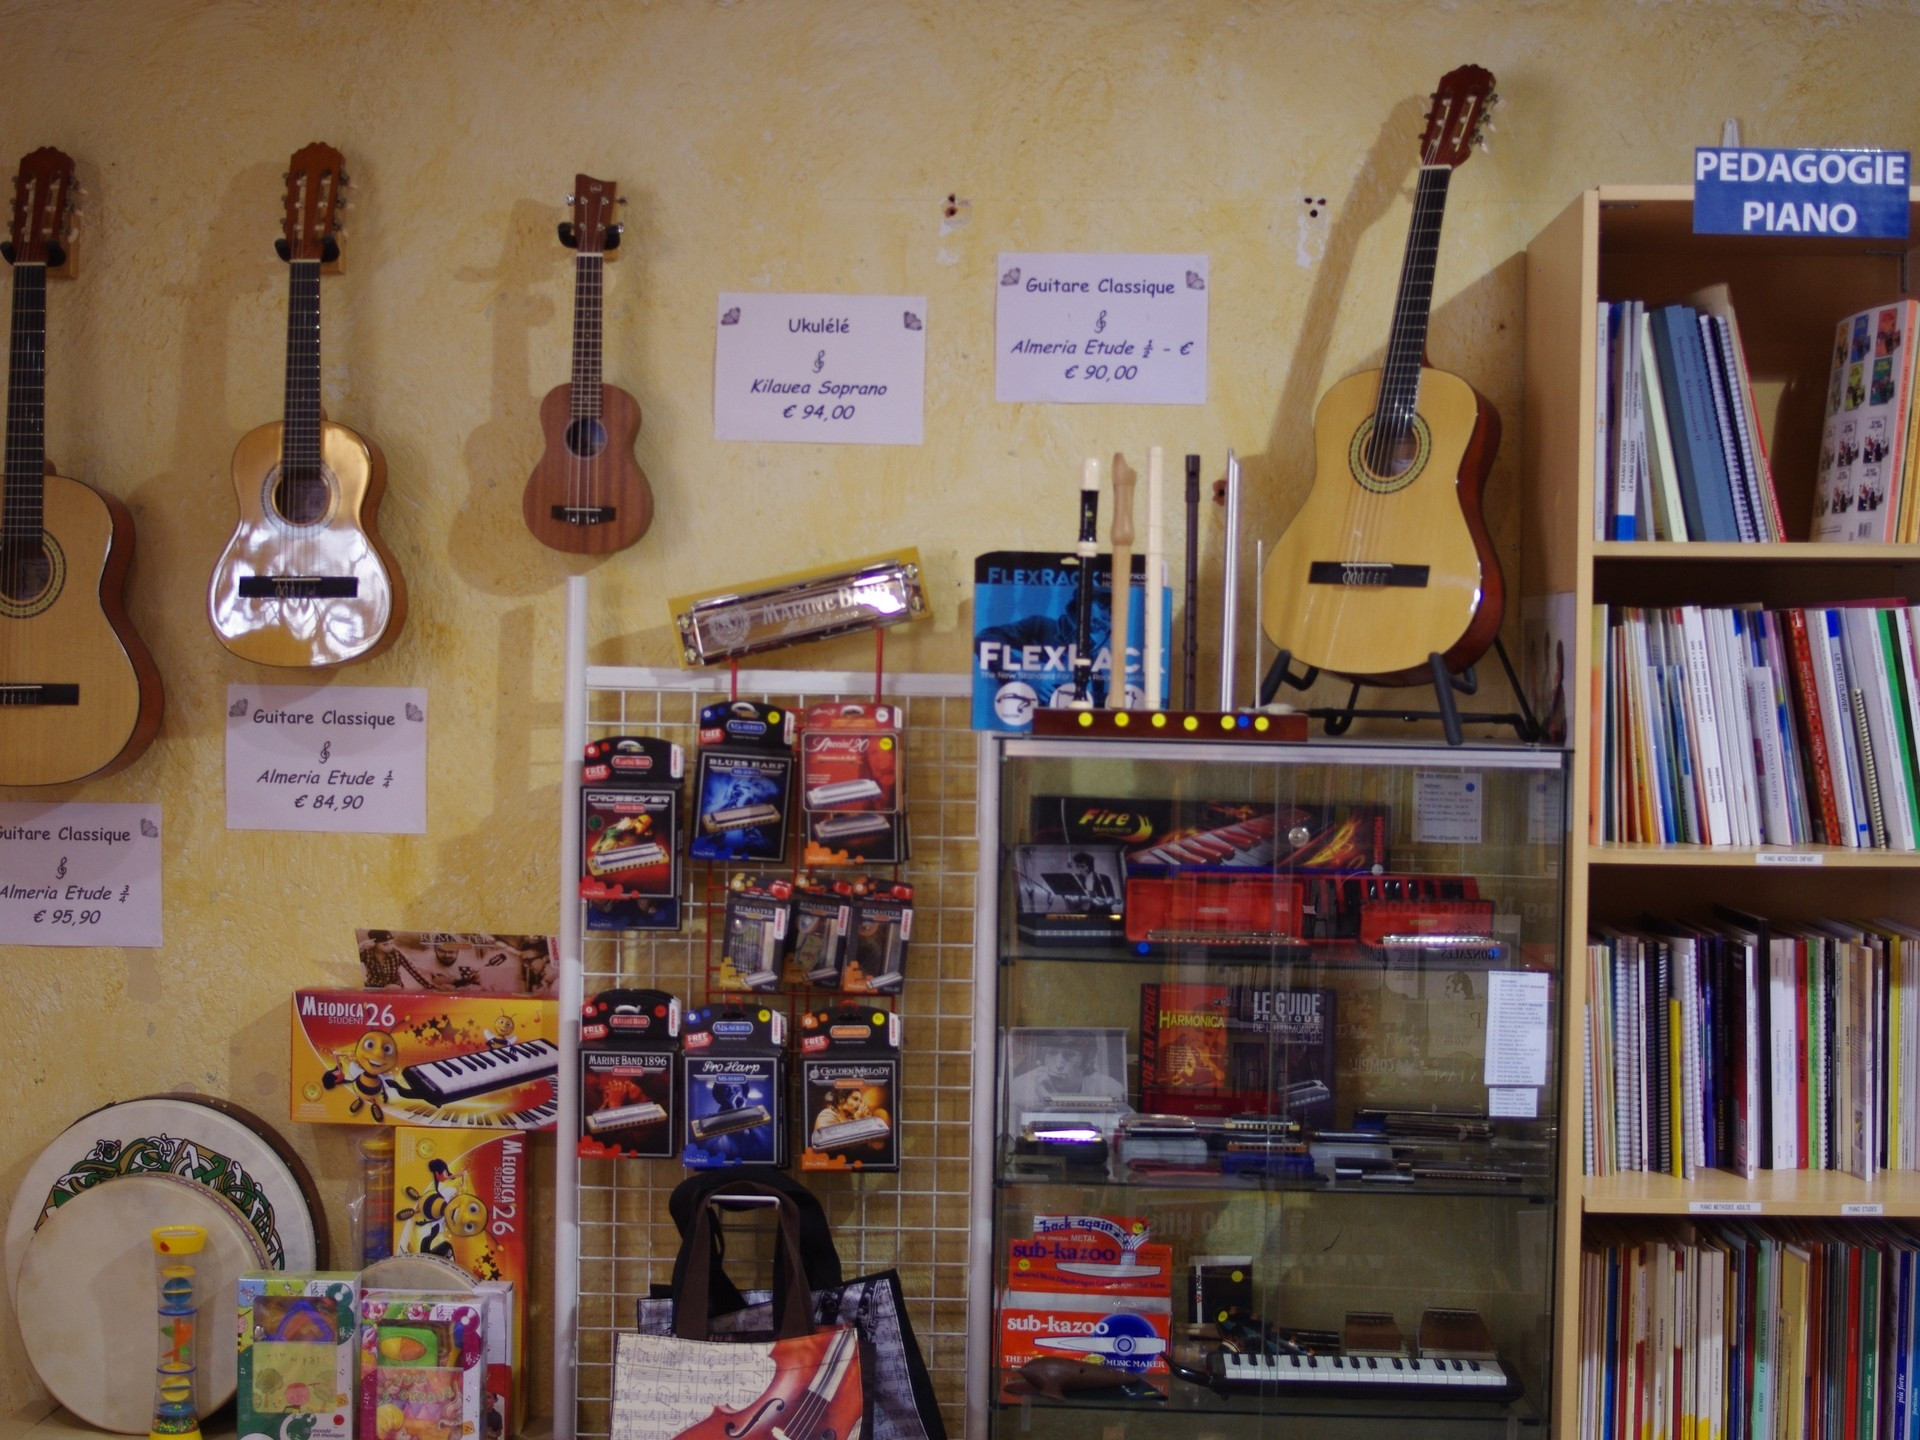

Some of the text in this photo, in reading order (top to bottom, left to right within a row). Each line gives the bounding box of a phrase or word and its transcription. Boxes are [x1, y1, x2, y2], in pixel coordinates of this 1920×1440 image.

[1696, 151, 1905, 185] PEDAGOGIE
[1743, 202, 1857, 232] PIANO
[1026, 277, 1175, 298] Guitare Classique
[788, 318, 850, 334] Ukulélé
[1010, 339, 1077, 354] Almeria
[1084, 339, 1134, 355] Etude
[1064, 365, 1138, 382] € 90,00
[750, 378, 887, 399] Kilauea Soprano
[783, 404, 855, 422] € 94,00
[1834, 653, 1849, 713] LE PETIT CLAVIER
[253, 709, 395, 730] Guitare Classique
[709, 758, 785, 770] BLUES HARP
[256, 769, 320, 784] Almeria
[327, 770, 375, 785] Etude
[294, 795, 364, 812] € 84,90
[588, 794, 670, 803] CROSSOVER
[1079, 808, 1130, 826] Fire
[58, 826, 131, 845] Classique
[0, 884, 58, 900] Almeria
[65, 885, 112, 900] Etude
[33, 910, 101, 926] € 95,90
[735, 905, 774, 915] REMASTER
[862, 908, 900, 917] REMASTER
[302, 996, 396, 1027] MELODICA 26
[1253, 991, 1320, 1016] LE GUIDE
[328, 1016, 364, 1025] STUDENT
[1159, 1010, 1225, 1029] HARMONICA
[1253, 1014, 1320, 1023] PRATIQUE
[584, 1025, 604, 1033] FREE
[688, 1032, 708, 1042] FREE
[804, 1036, 825, 1045] FREE
[589, 1055, 667, 1066] MARINE BAND 1896
[703, 1060, 760, 1074] Pro Harp
[854, 1066, 890, 1078] MELODY
[491, 1139, 523, 1236] MELODICA 26
[1071, 1235, 1098, 1243] METAL
[1013, 1241, 1116, 1261] sub-kazoo
[1007, 1314, 1109, 1334] sub-kazoo
[1005, 1355, 1165, 1368] THE MUSIC MAKER
